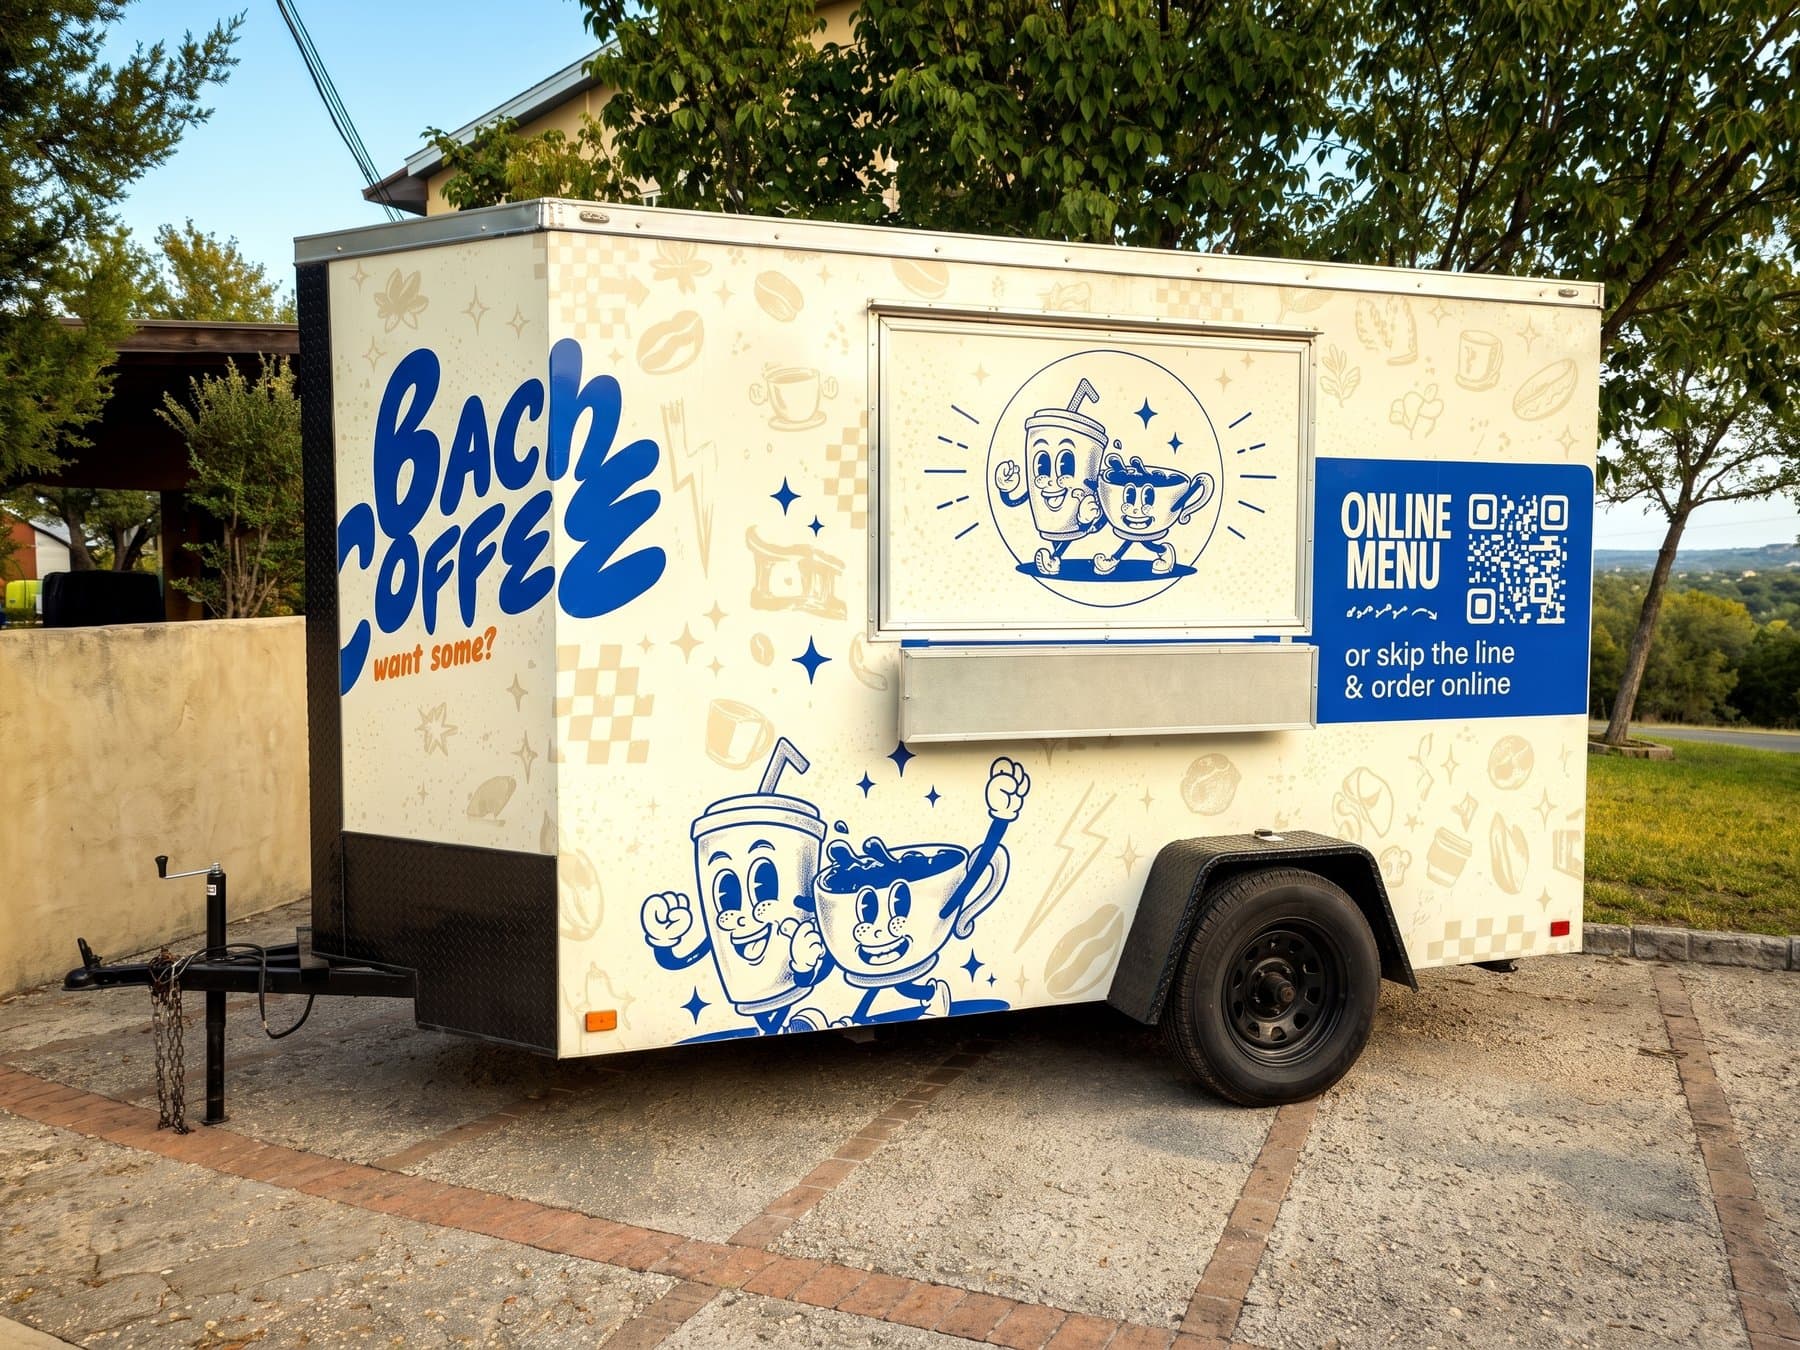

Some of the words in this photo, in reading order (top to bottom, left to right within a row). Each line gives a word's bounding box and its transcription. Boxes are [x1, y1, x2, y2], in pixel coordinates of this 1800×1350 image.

[1341, 491, 1452, 540] ONLINE
[1346, 540, 1440, 590] MENU
[373, 645, 423, 682] want
[430, 626, 497, 671] some?
[1345, 648, 1371, 667] or
[1376, 641, 1425, 672] skip
[1431, 640, 1469, 666] the
[1475, 639, 1516, 664] line
[1344, 674, 1364, 699] &
[1371, 672, 1435, 699] order
[1441, 671, 1511, 697] online
